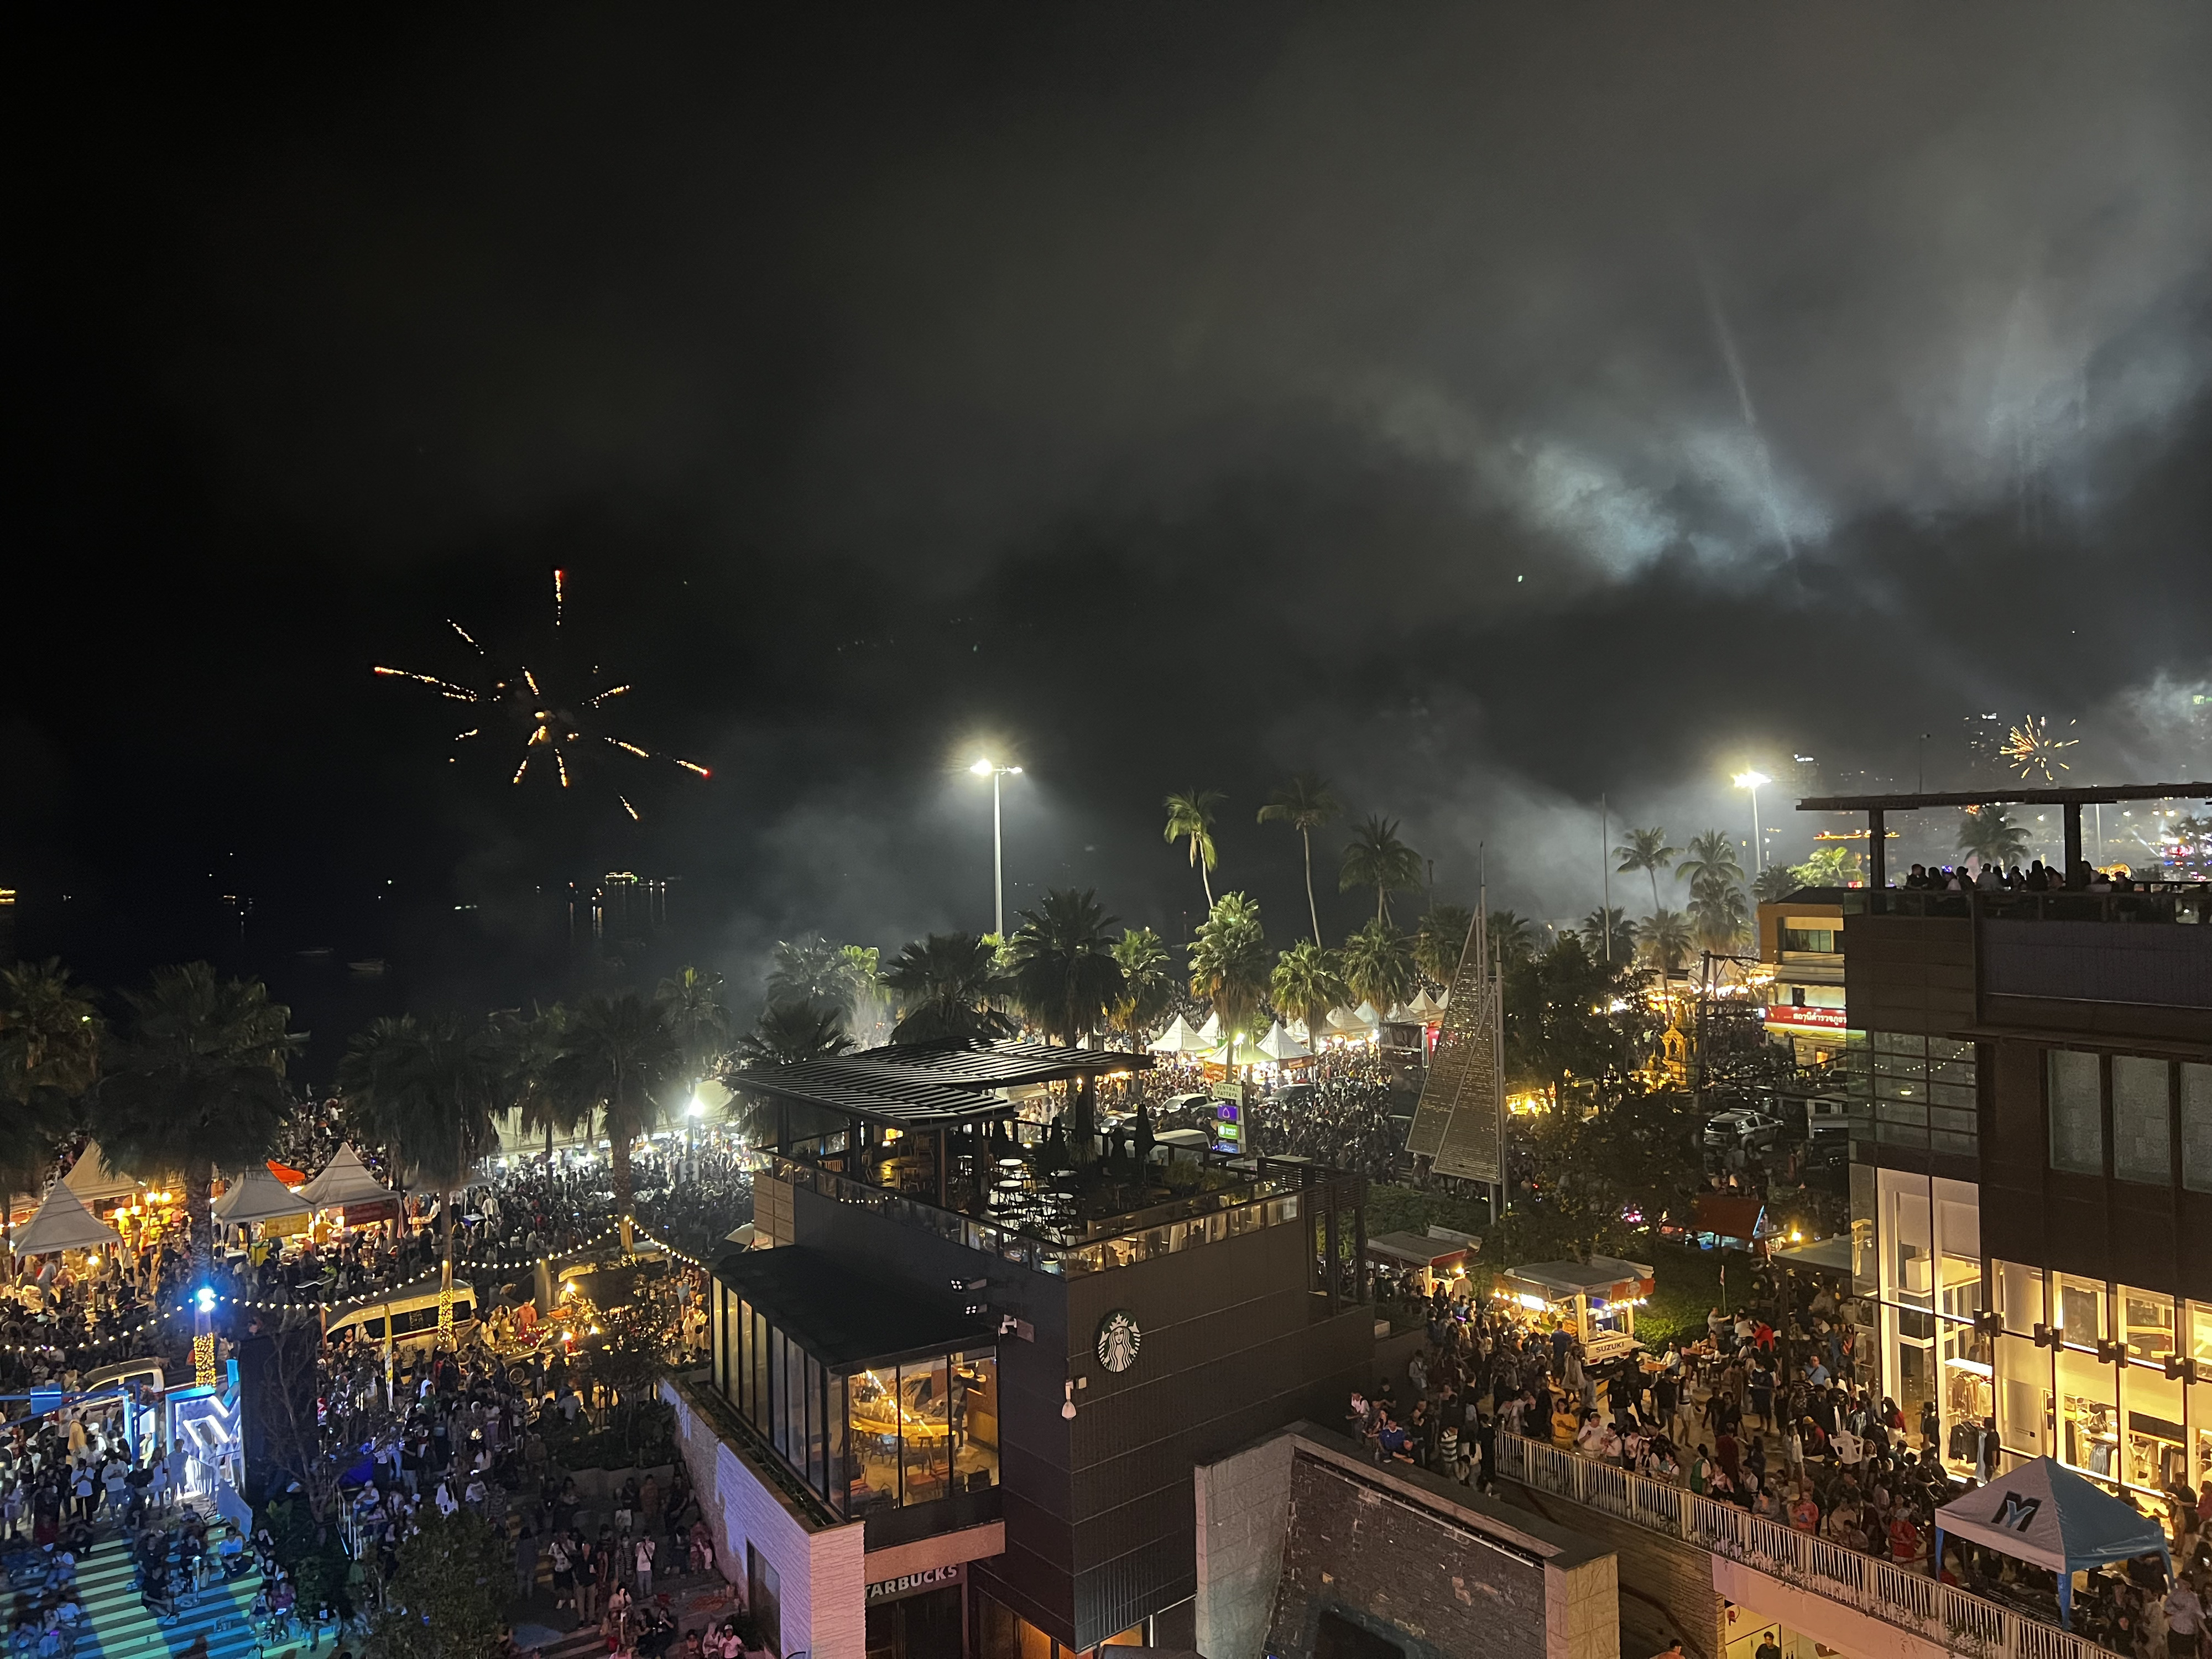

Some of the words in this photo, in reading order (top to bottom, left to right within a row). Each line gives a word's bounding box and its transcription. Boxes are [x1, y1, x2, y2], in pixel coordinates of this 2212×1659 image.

[1216, 1084, 1239, 1093] CENTRAL
[1596, 1342, 1624, 1353] SUZUKI
[865, 1564, 957, 1599] TARBUCKS
